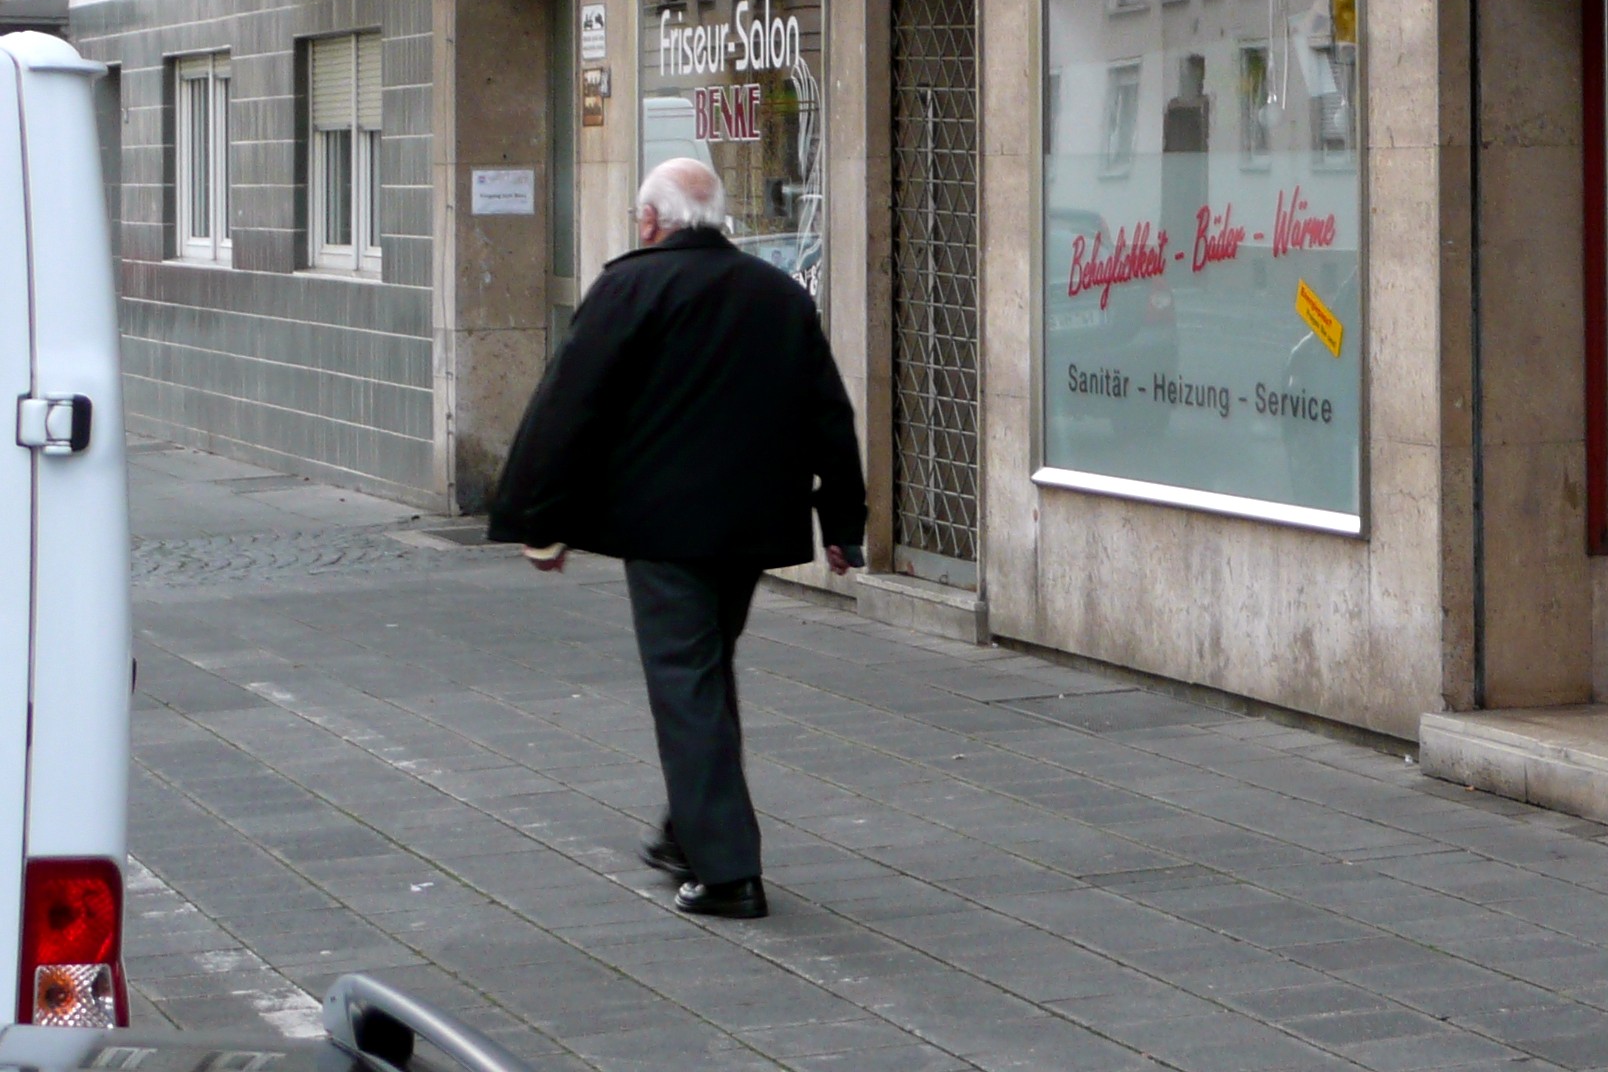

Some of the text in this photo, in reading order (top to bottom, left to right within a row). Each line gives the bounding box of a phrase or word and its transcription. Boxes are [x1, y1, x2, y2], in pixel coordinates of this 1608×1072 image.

[694, 83, 761, 142] BENKE
[1068, 221, 1168, 310] Behaglichkeit
[1192, 203, 1245, 272] Bäder
[1273, 185, 1336, 257] Wärme
[1068, 364, 1129, 398] Sanitär
[1153, 373, 1230, 417] Heizung
[1255, 382, 1332, 424] Service
